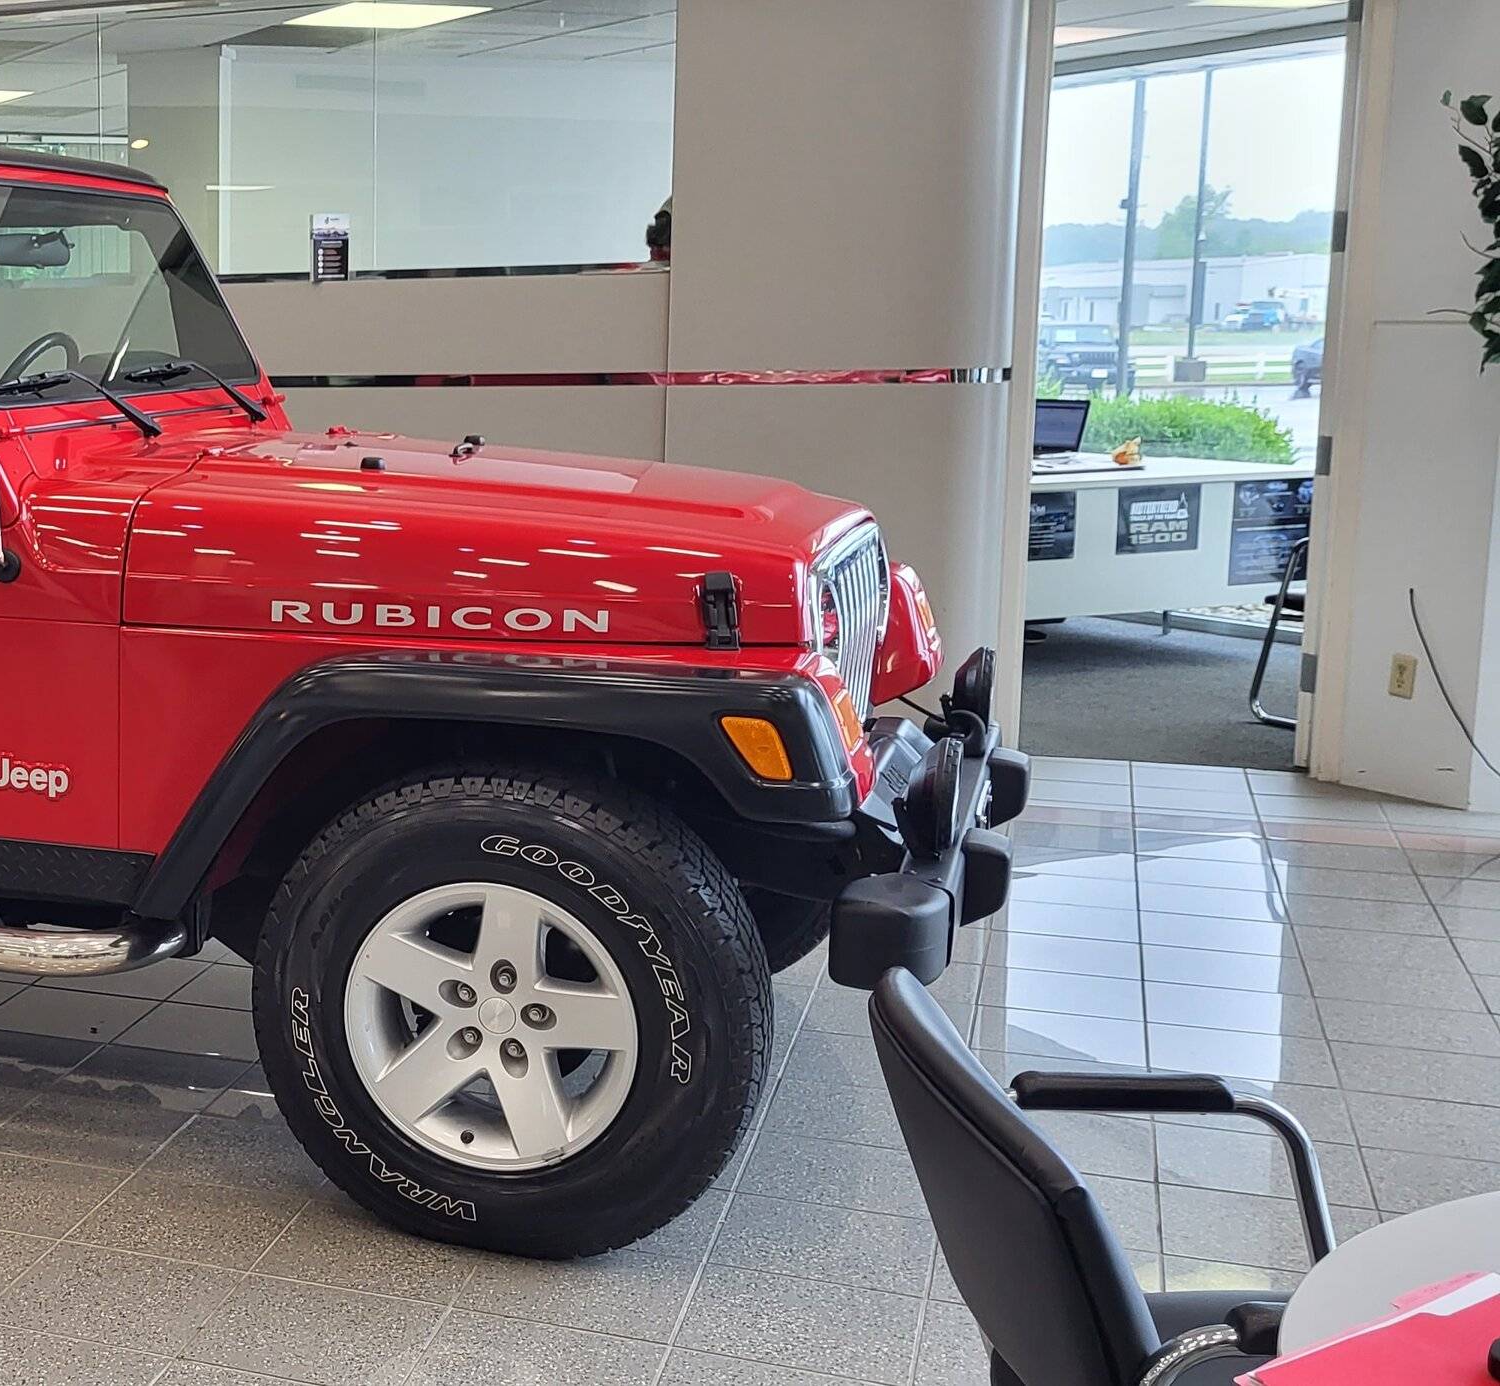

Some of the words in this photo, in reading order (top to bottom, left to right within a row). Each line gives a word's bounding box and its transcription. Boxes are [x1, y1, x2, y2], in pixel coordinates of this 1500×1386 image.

[1128, 531, 1188, 545] 1500
[1129, 520, 1189, 534] RAM
[270, 600, 610, 633] RUBICON
[480, 834, 691, 1086] GOODYEAR
[289, 986, 478, 1222] WRANGLER
